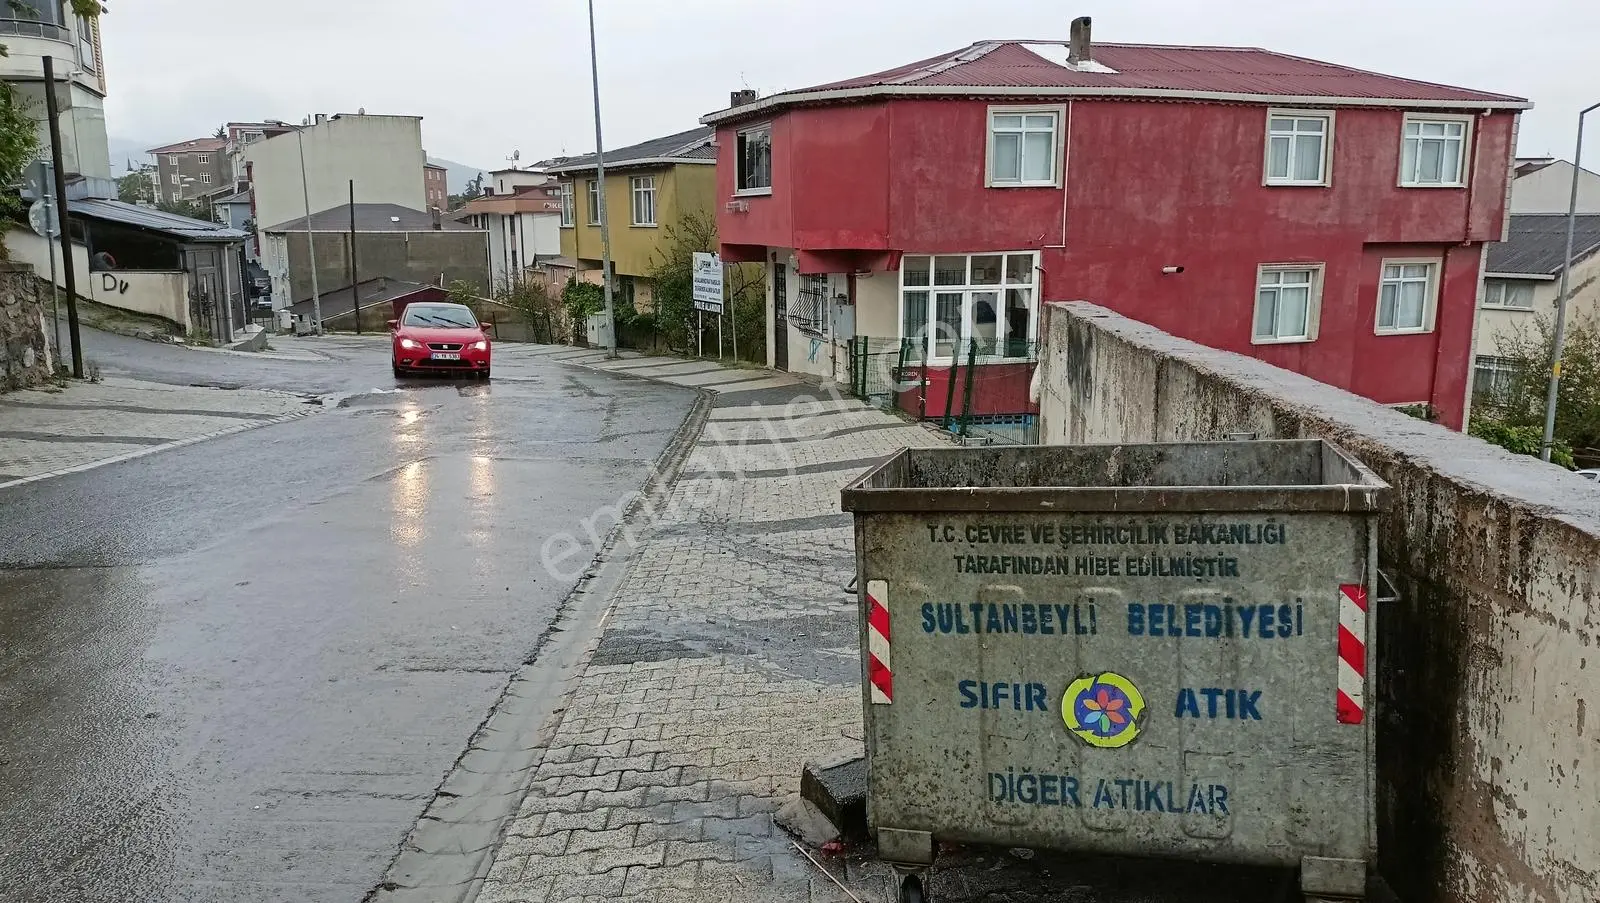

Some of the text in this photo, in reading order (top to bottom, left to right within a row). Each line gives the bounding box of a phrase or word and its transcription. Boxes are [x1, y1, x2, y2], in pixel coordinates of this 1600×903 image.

[965, 523, 1026, 548] ÇEVRE
[1030, 523, 1055, 545] VE
[1174, 518, 1286, 545] BAKANLIĞI
[953, 551, 1241, 583] TARAFINDAN HİBE EDİLMİŞTİR
[920, 597, 1304, 639] SULTANBEYLİ BELEDİYESİ
[958, 679, 1264, 721] SIFIR ATIK
[987, 766, 1231, 816] DİĞER ATIKLAR
